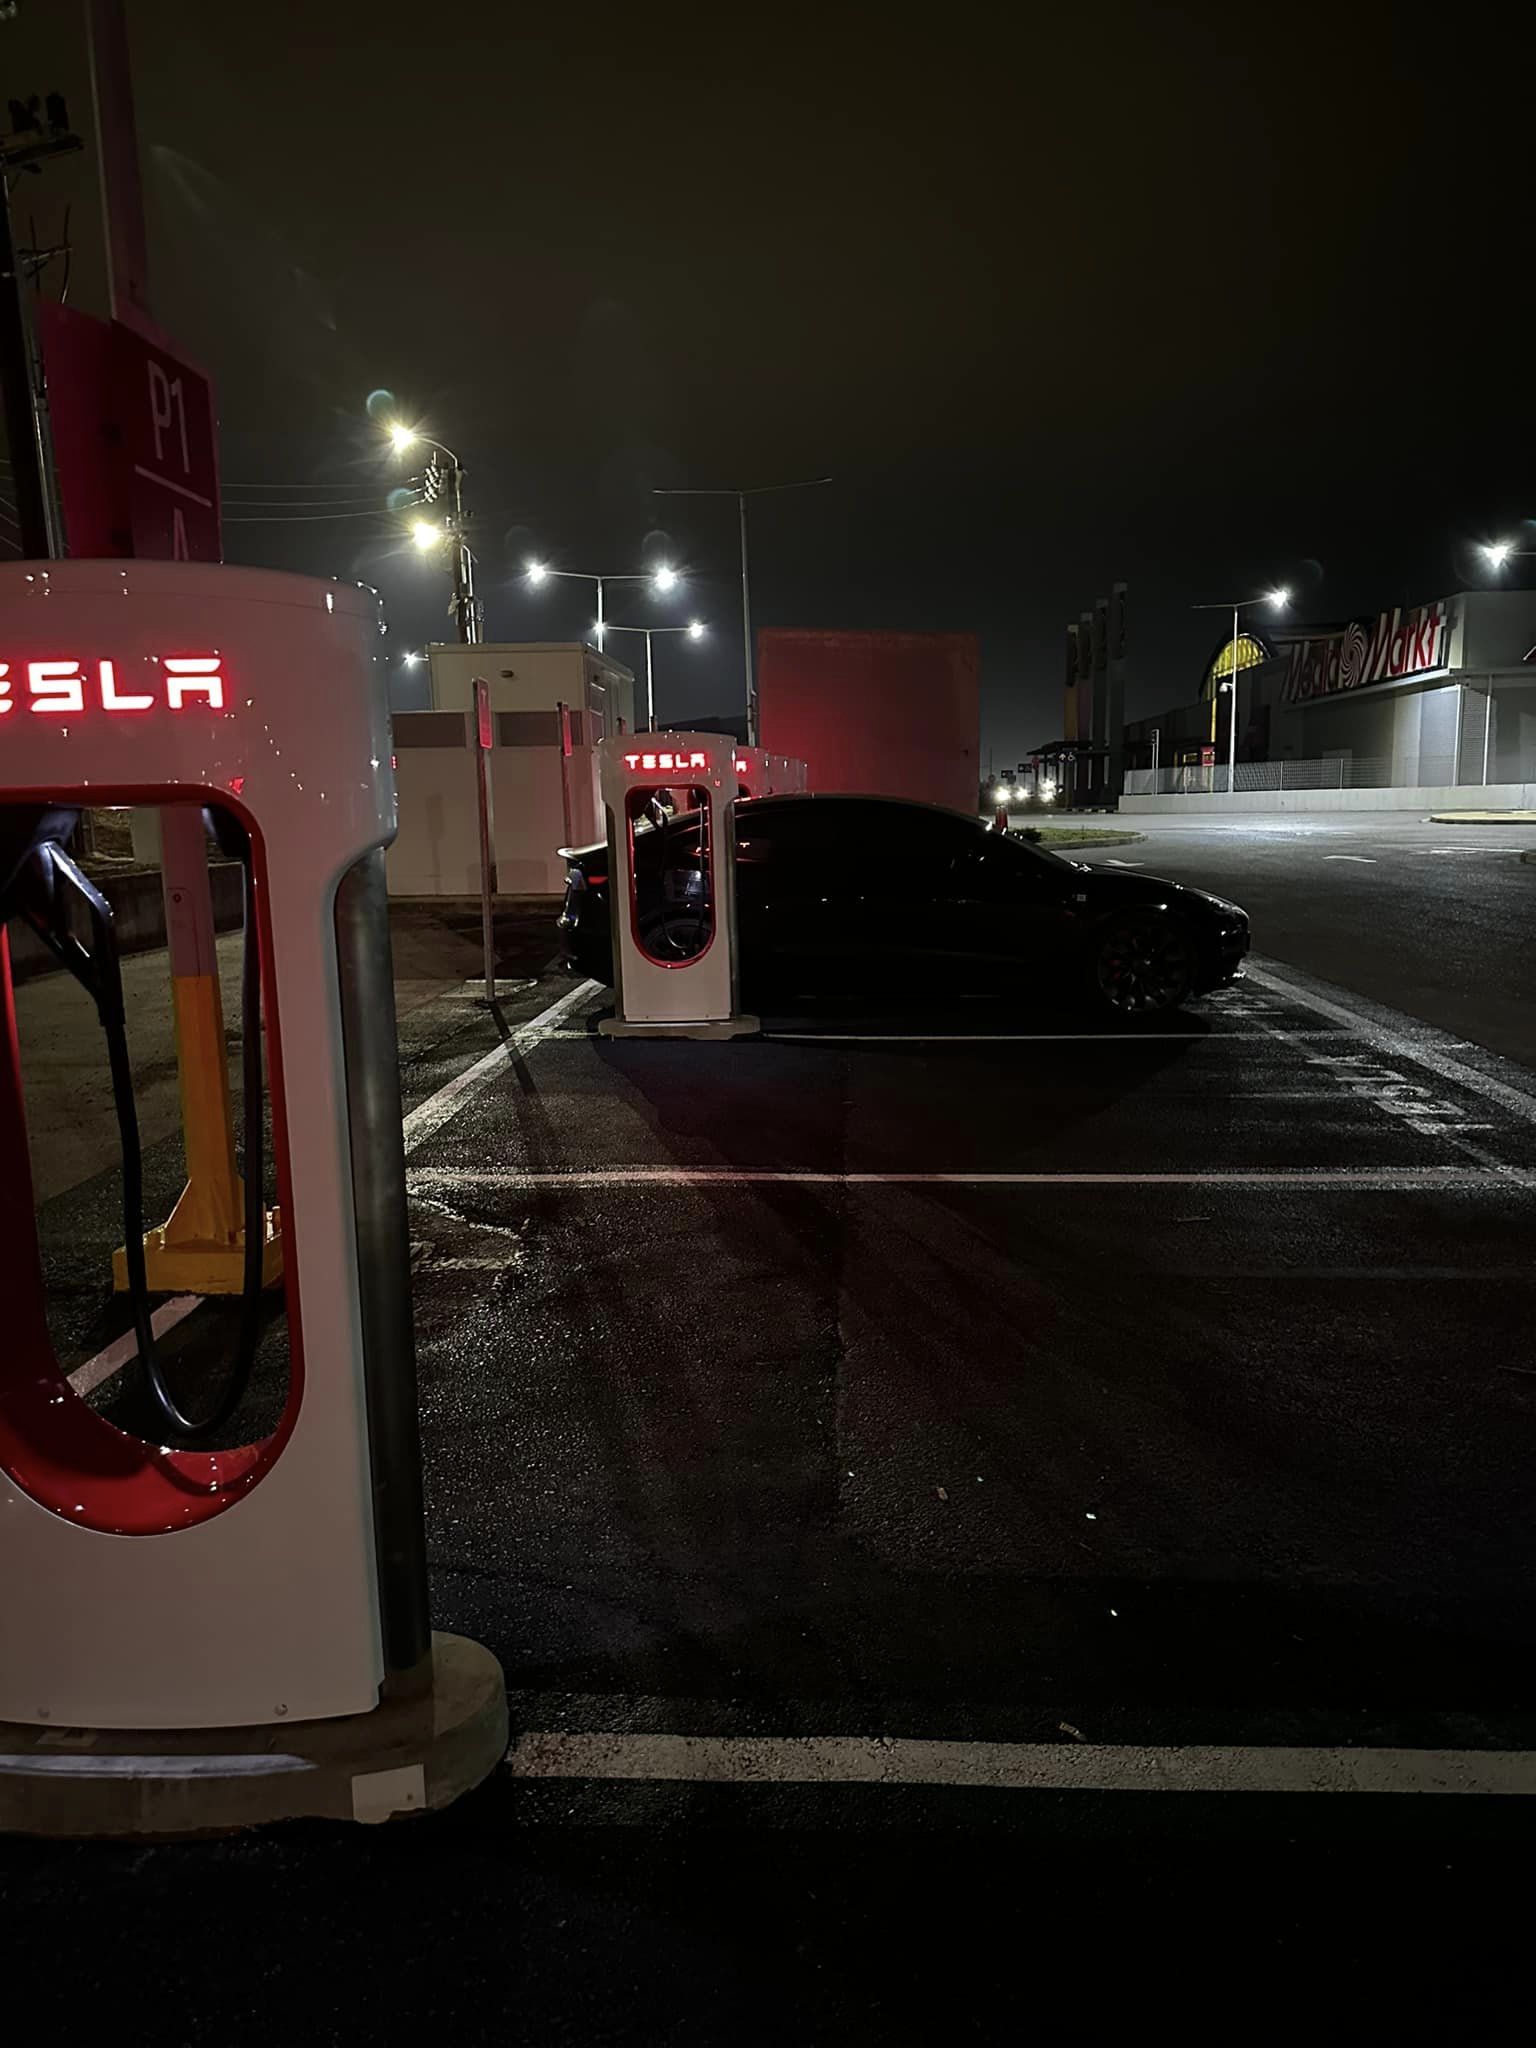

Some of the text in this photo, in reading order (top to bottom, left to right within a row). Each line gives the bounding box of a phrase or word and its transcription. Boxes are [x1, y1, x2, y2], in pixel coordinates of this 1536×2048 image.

[147, 360, 191, 475] P1
[1360, 602, 1447, 683] Markt
[624, 752, 706, 770] TESLA
